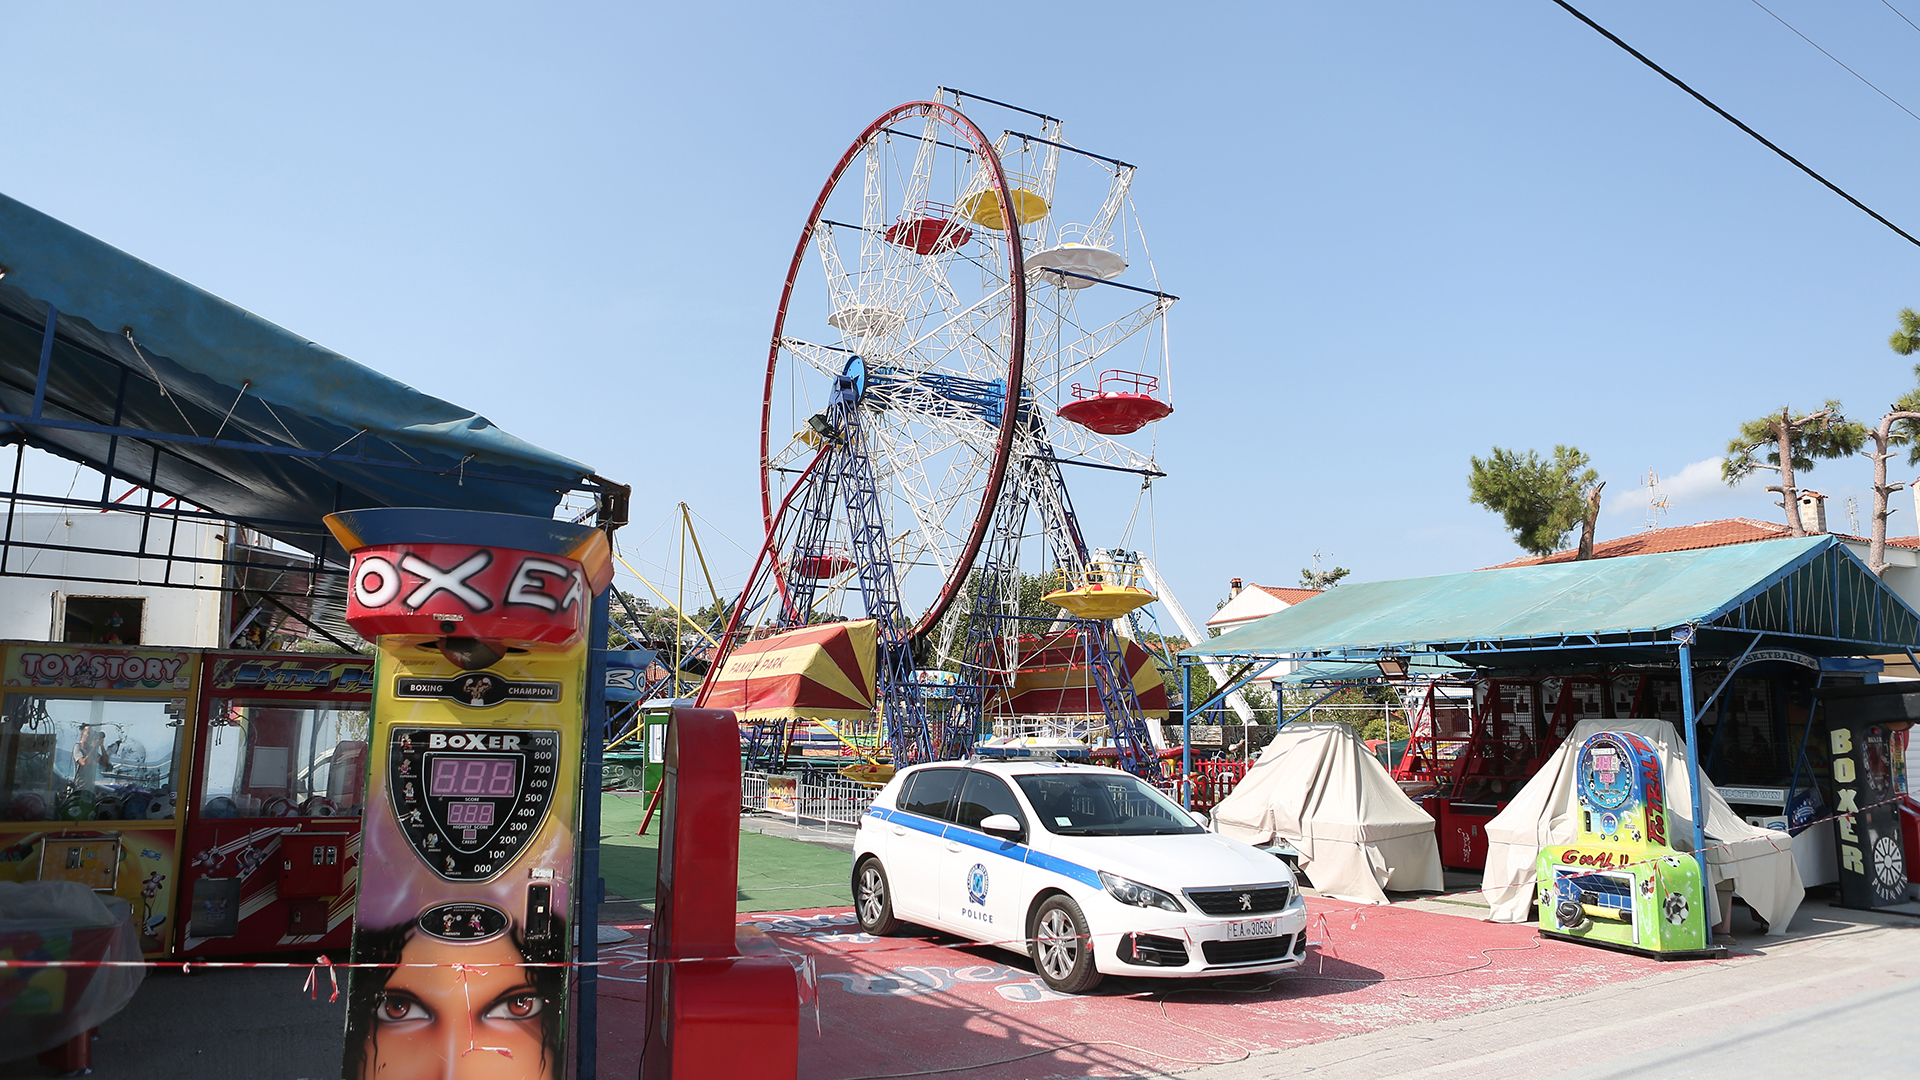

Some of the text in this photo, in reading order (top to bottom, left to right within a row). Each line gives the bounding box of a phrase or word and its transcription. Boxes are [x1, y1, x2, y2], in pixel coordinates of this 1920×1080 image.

[19, 652, 184, 683] TOY STORY
[760, 655, 788, 671] PARK
[234, 663, 333, 687] EXTRA
[410, 684, 553, 696] BOXING CHAMPION
[429, 733, 521, 751] BOXER
[535, 737, 553, 746] 900
[534, 751, 552, 761] 800
[534, 765, 551, 775] 700
[530, 779, 548, 789] 600
[525, 794, 543, 803] 500
[1759, 790, 1781, 800] WIN
[1830, 727, 1865, 876] BOXER
[517, 808, 535, 818] 400
[510, 822, 528, 832] 300
[499, 836, 517, 846] 200
[489, 850, 506, 860] 100
[474, 864, 492, 874] 000
[962, 907, 993, 924] POLICE
